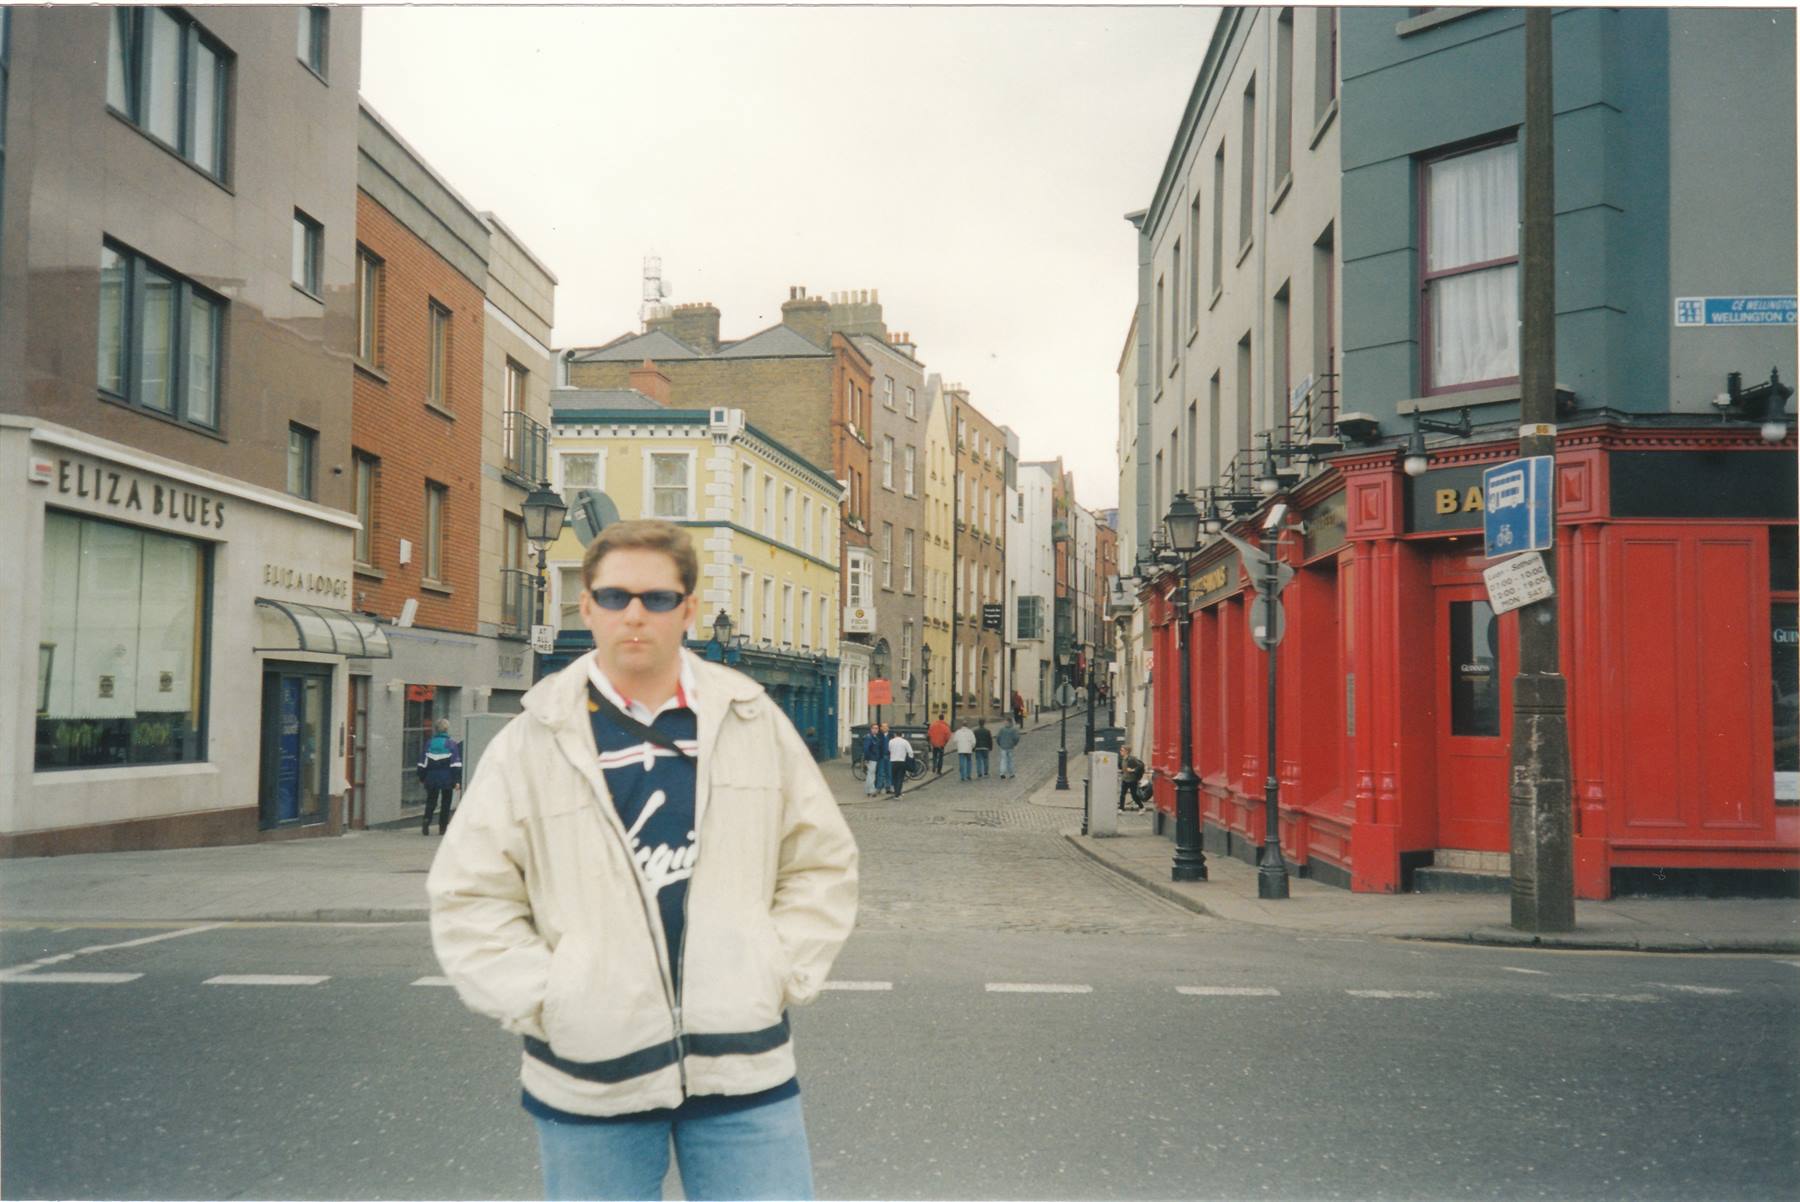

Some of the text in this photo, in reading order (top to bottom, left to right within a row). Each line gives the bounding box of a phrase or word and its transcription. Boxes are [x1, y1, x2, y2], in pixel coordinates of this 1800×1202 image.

[1711, 312, 1783, 323] WELLINGTON
[58, 459, 225, 530] ELIZA BLUES
[1436, 486, 1485, 514] BA
[263, 564, 347, 599] ELIZA LODGE
